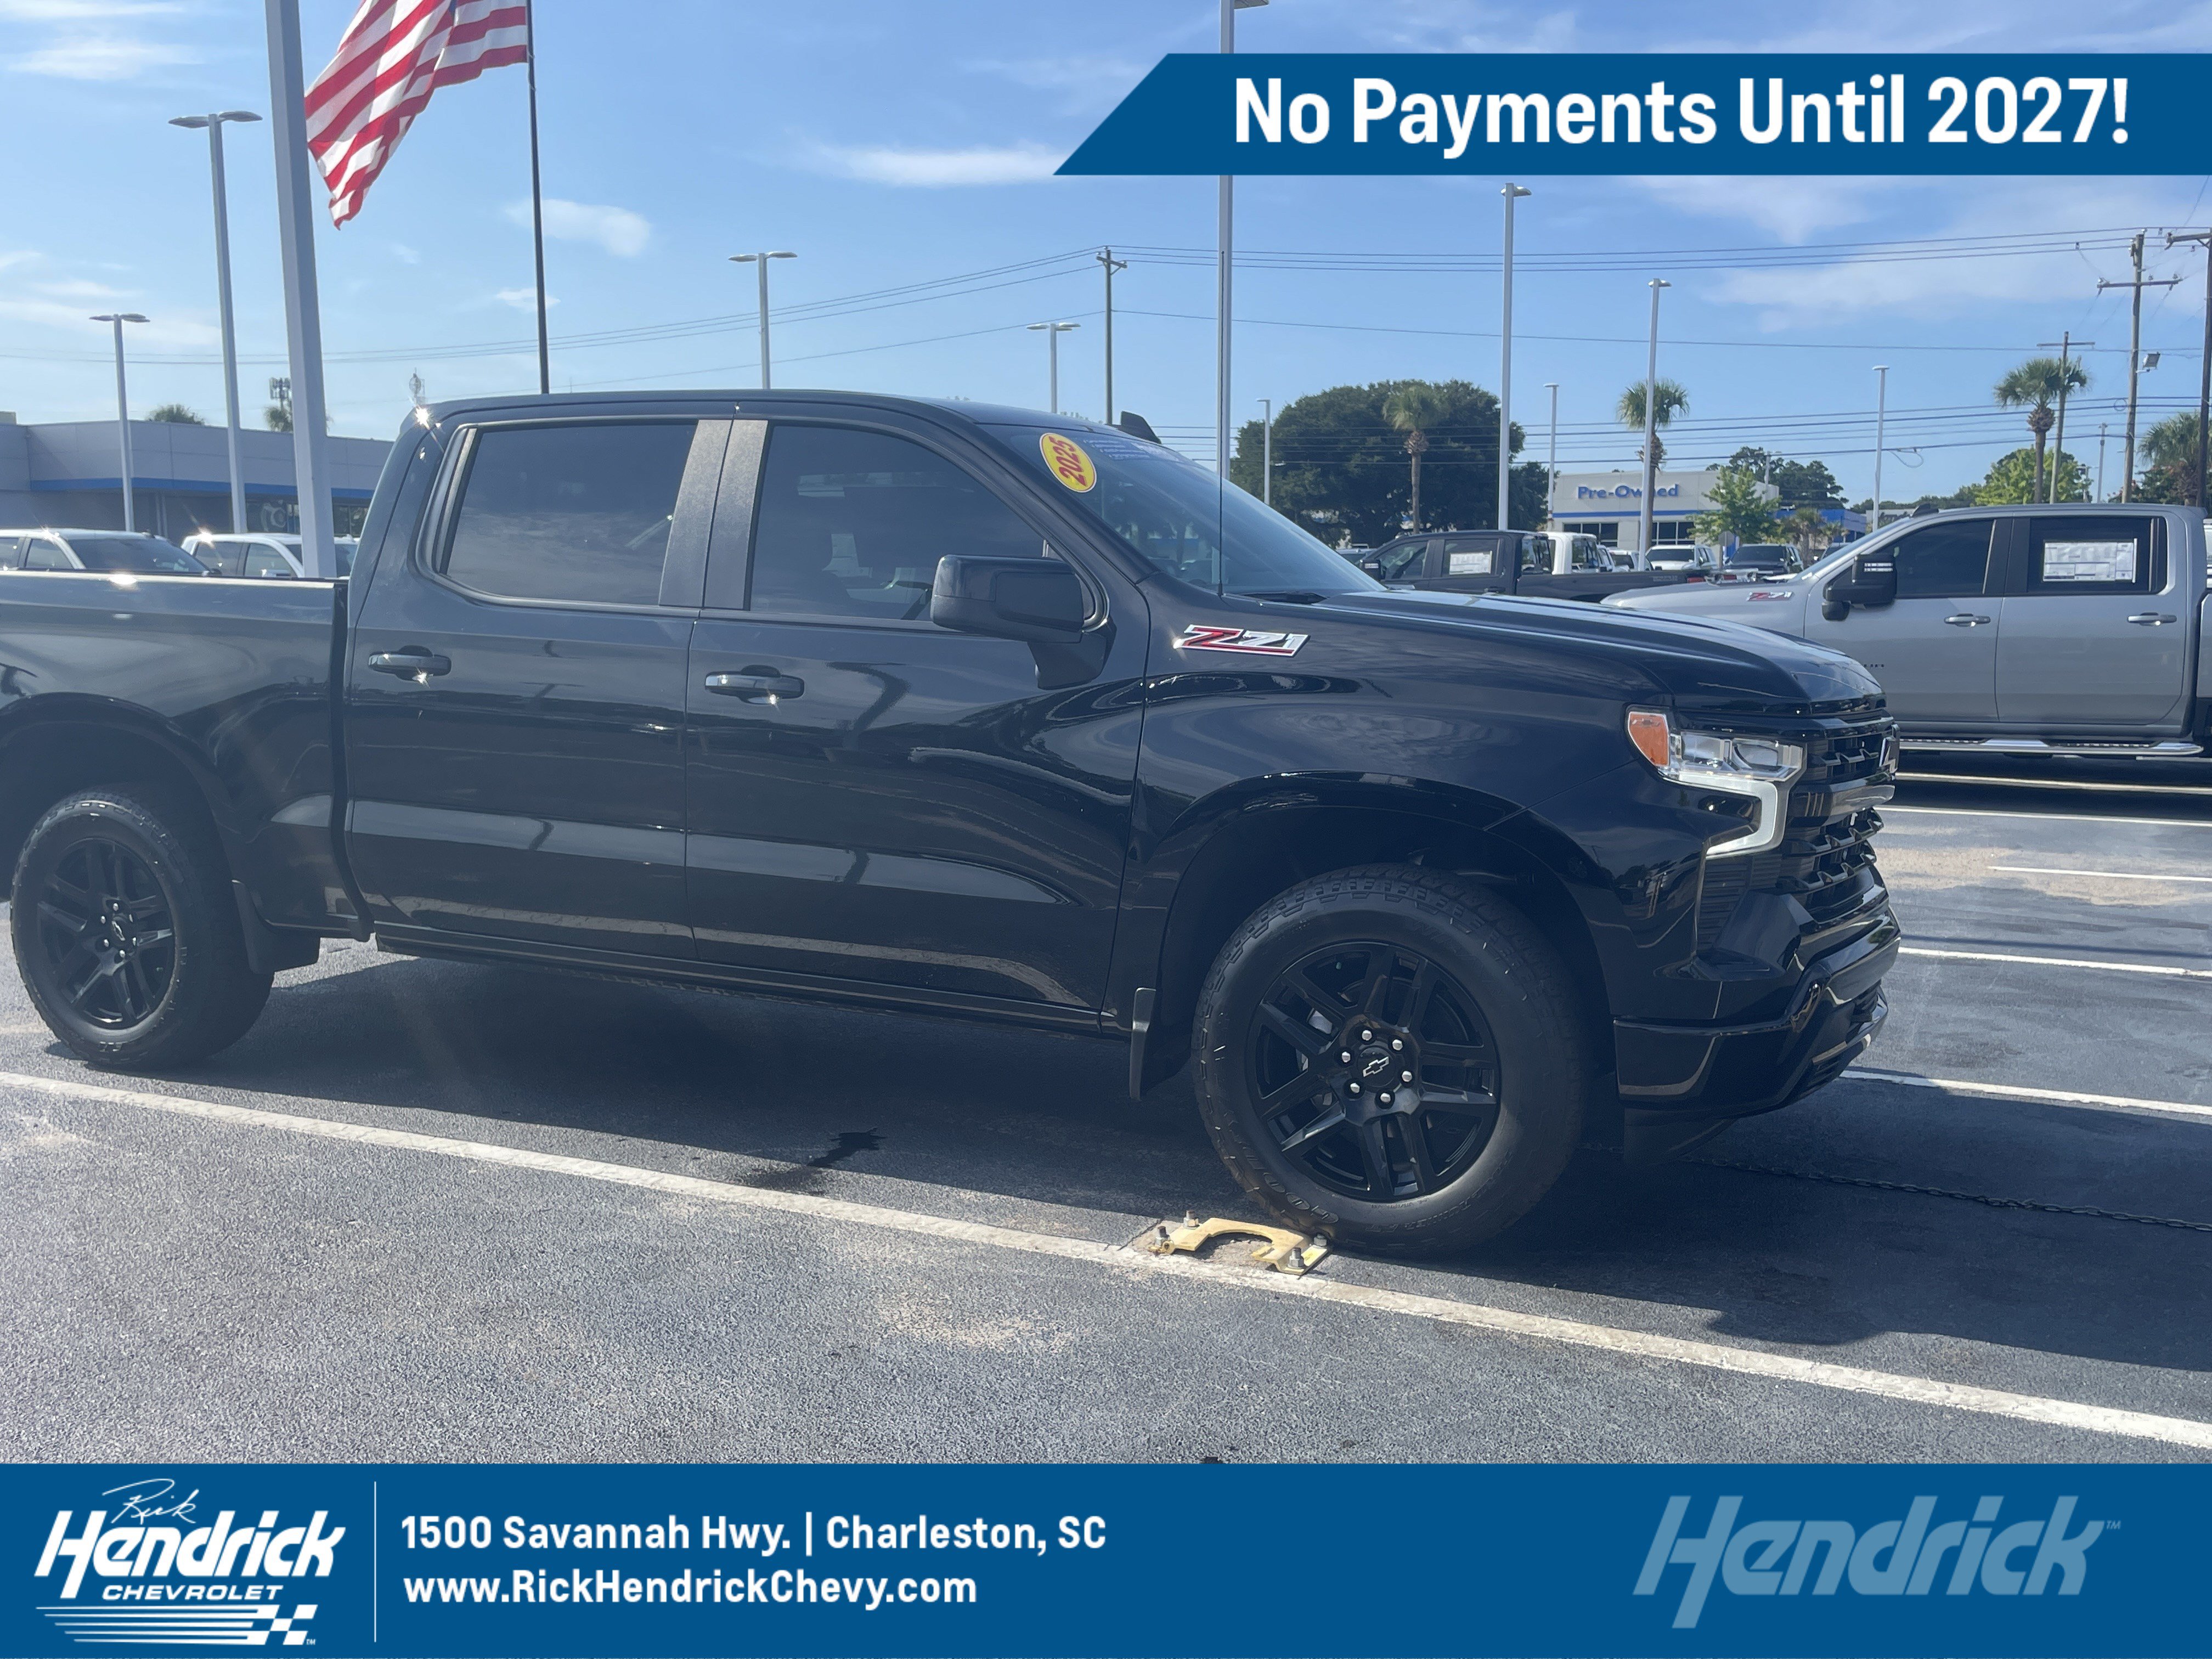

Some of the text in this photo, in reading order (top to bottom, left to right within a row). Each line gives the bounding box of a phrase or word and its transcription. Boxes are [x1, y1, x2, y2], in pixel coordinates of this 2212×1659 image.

[1048, 436, 1087, 487] 2025
[1578, 484, 1679, 499] Pre-Owed
[1173, 624, 1310, 657] Z71
